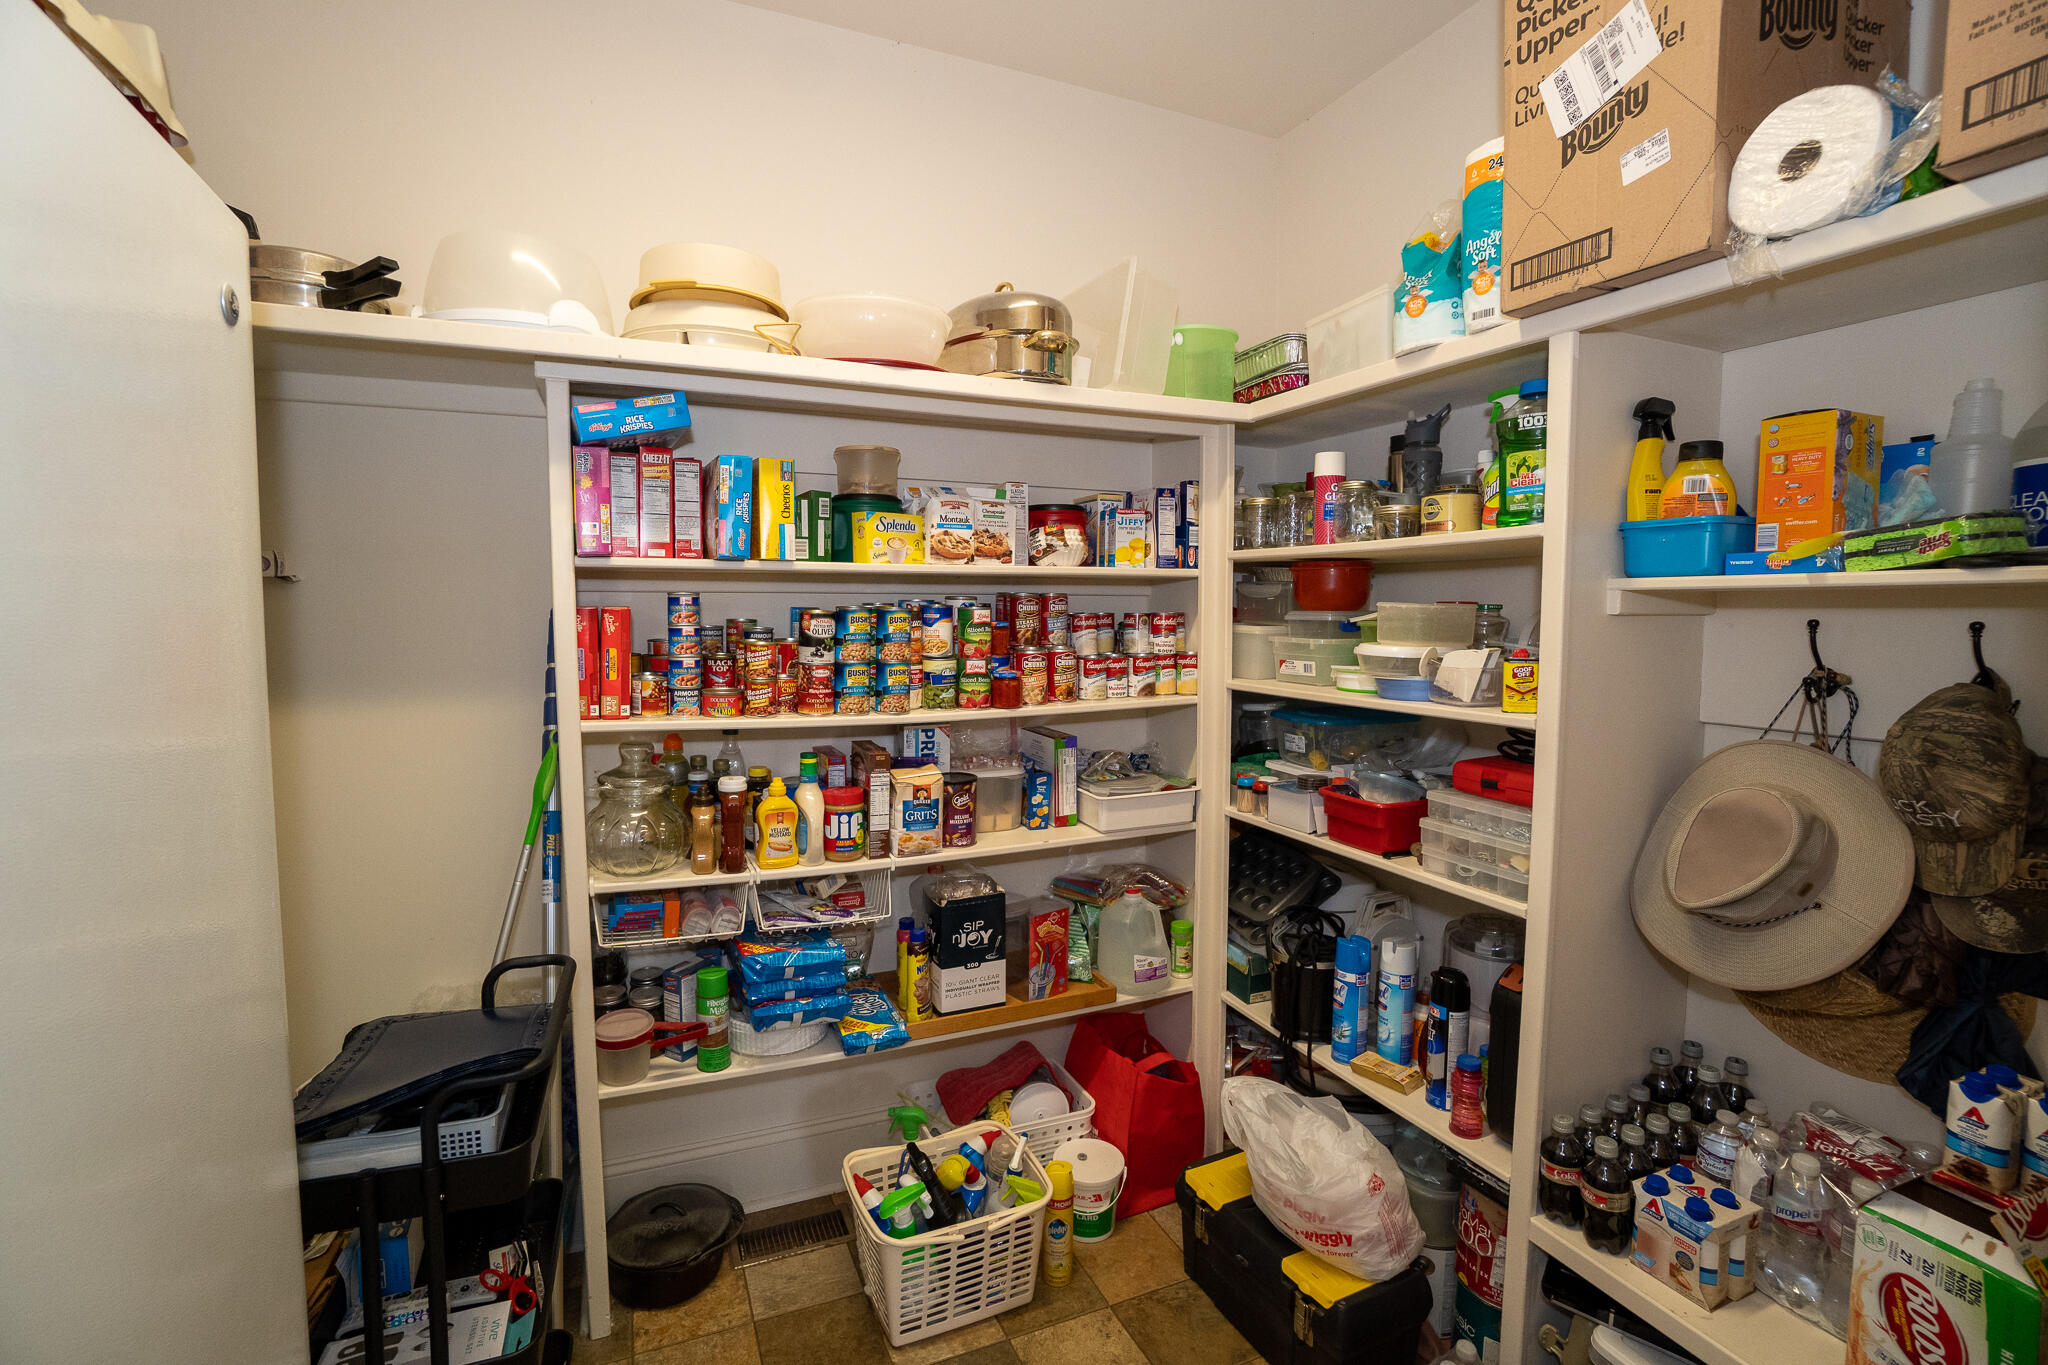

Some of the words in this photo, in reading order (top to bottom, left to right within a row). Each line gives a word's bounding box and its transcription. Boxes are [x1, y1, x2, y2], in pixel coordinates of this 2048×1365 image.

[1760, 0, 1838, 42] Bounty
[1562, 80, 1649, 169] Bounty
[1488, 155, 1504, 171] 24
[1465, 229, 1502, 257] Angel
[1472, 246, 1500, 266] Soft
[1408, 299, 1424, 309] 425
[626, 414, 645, 425] RICE
[620, 422, 653, 434] KRISPIES
[582, 452, 590, 473] Raisin
[1519, 472, 1537, 480] Mr.
[1510, 478, 1542, 488] Clean
[781, 484, 791, 519] Cheerios
[876, 516, 916, 533] Splenda
[940, 515, 970, 523] Montauk
[1117, 516, 1145, 526] JIFFY
[1023, 660, 1046, 668] CHUNKY
[1513, 666, 1533, 674] GOOF
[953, 793, 969, 804] Gold
[905, 809, 938, 822] GRITS
[825, 812, 863, 840] Jif
[769, 831, 792, 839] MUSTARD
[963, 920, 984, 932] SIP
[980, 973, 1000, 981] CLEAR
[945, 991, 972, 999] PLASTIC
[974, 986, 1000, 995] STRAWS
[1702, 1158, 1728, 1173] Splash
[1554, 1169, 1580, 1182] Coke
[1642, 1208, 1664, 1221] ATKINS
[1776, 1206, 1811, 1220] propel
[1900, 1248, 1913, 1266] 27
[1921, 1257, 1936, 1279] 20g
[1944, 1265, 1956, 1296] PROTEIN
[1955, 1270, 1970, 1303] MORE
[1968, 1279, 1983, 1308] 100%
[1900, 1275, 1947, 1365] BOOS
